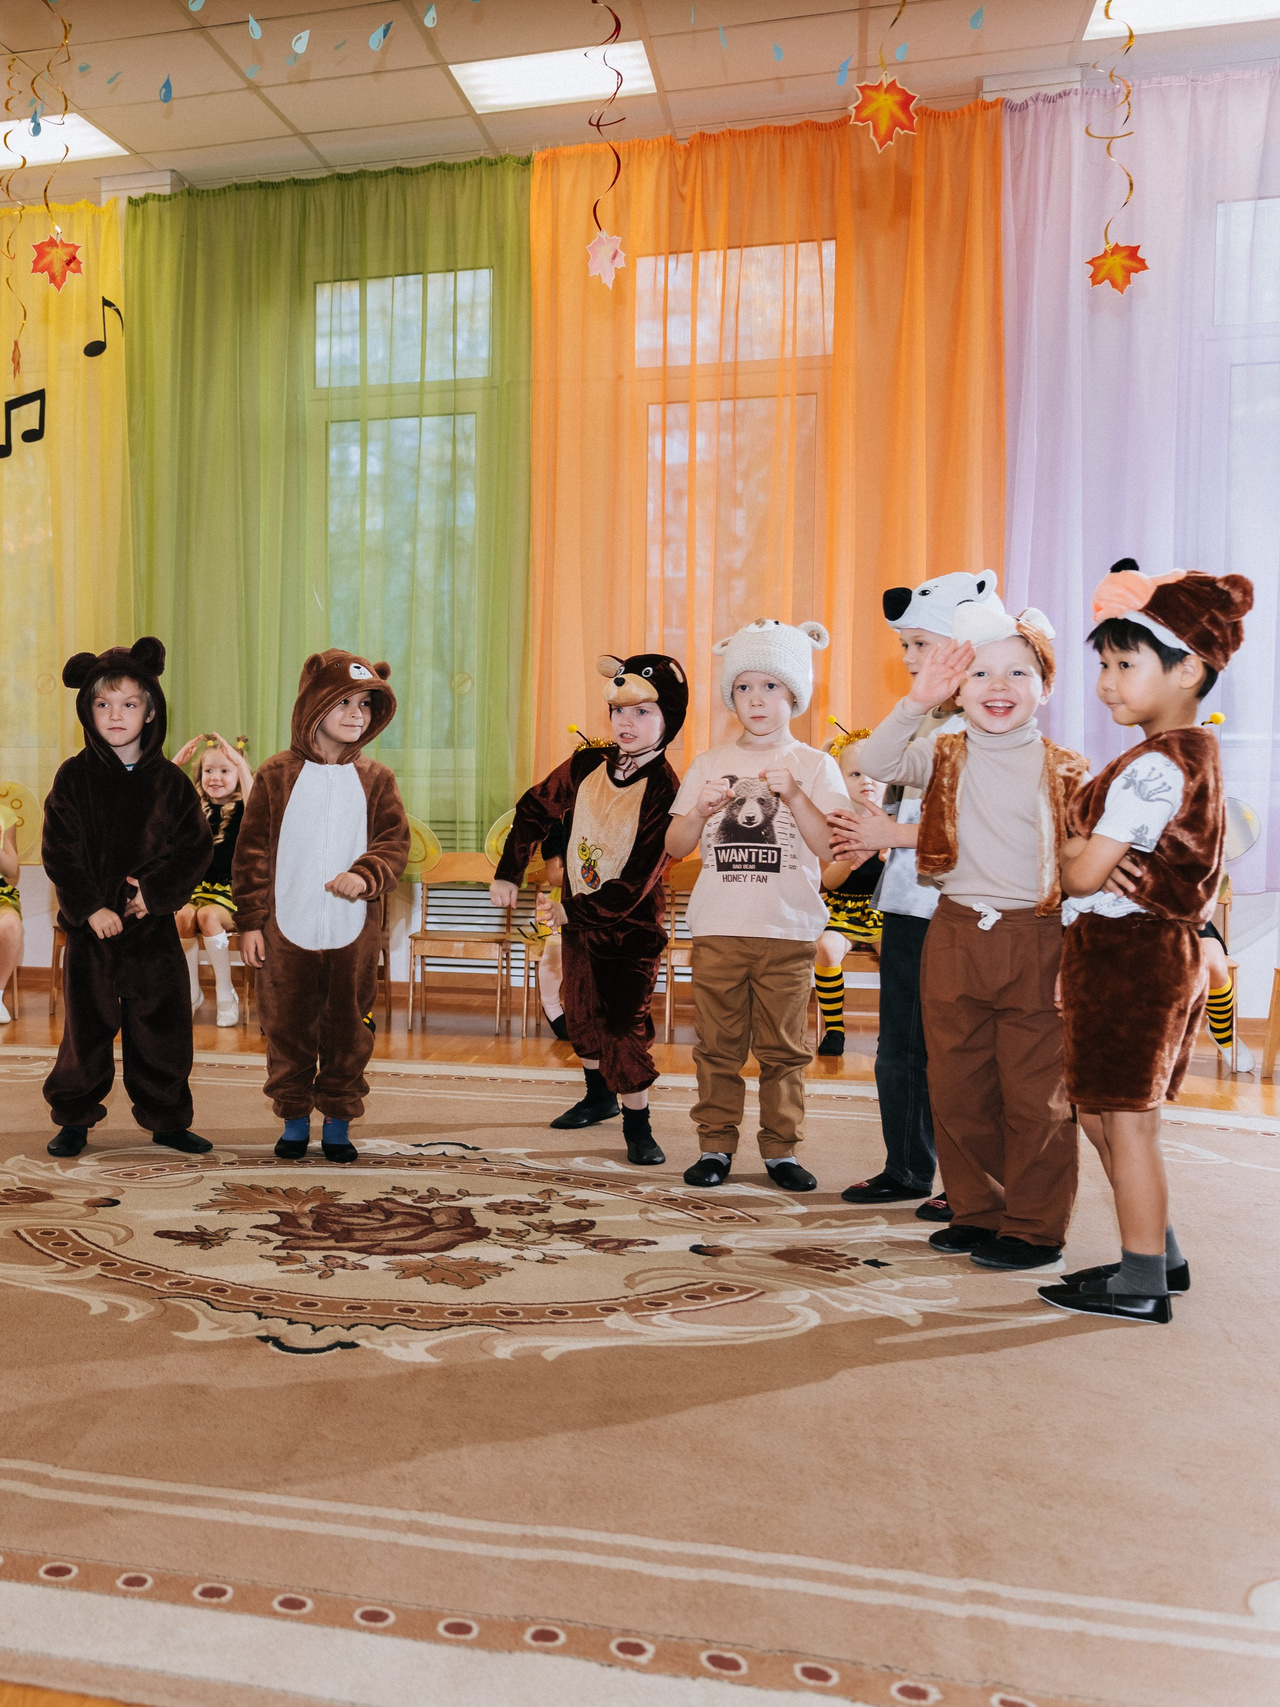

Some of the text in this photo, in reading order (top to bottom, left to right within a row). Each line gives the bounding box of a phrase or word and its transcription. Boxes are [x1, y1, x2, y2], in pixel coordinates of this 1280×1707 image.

[717, 848, 778, 864] WANTED
[722, 874, 768, 884] HONEY FAN
